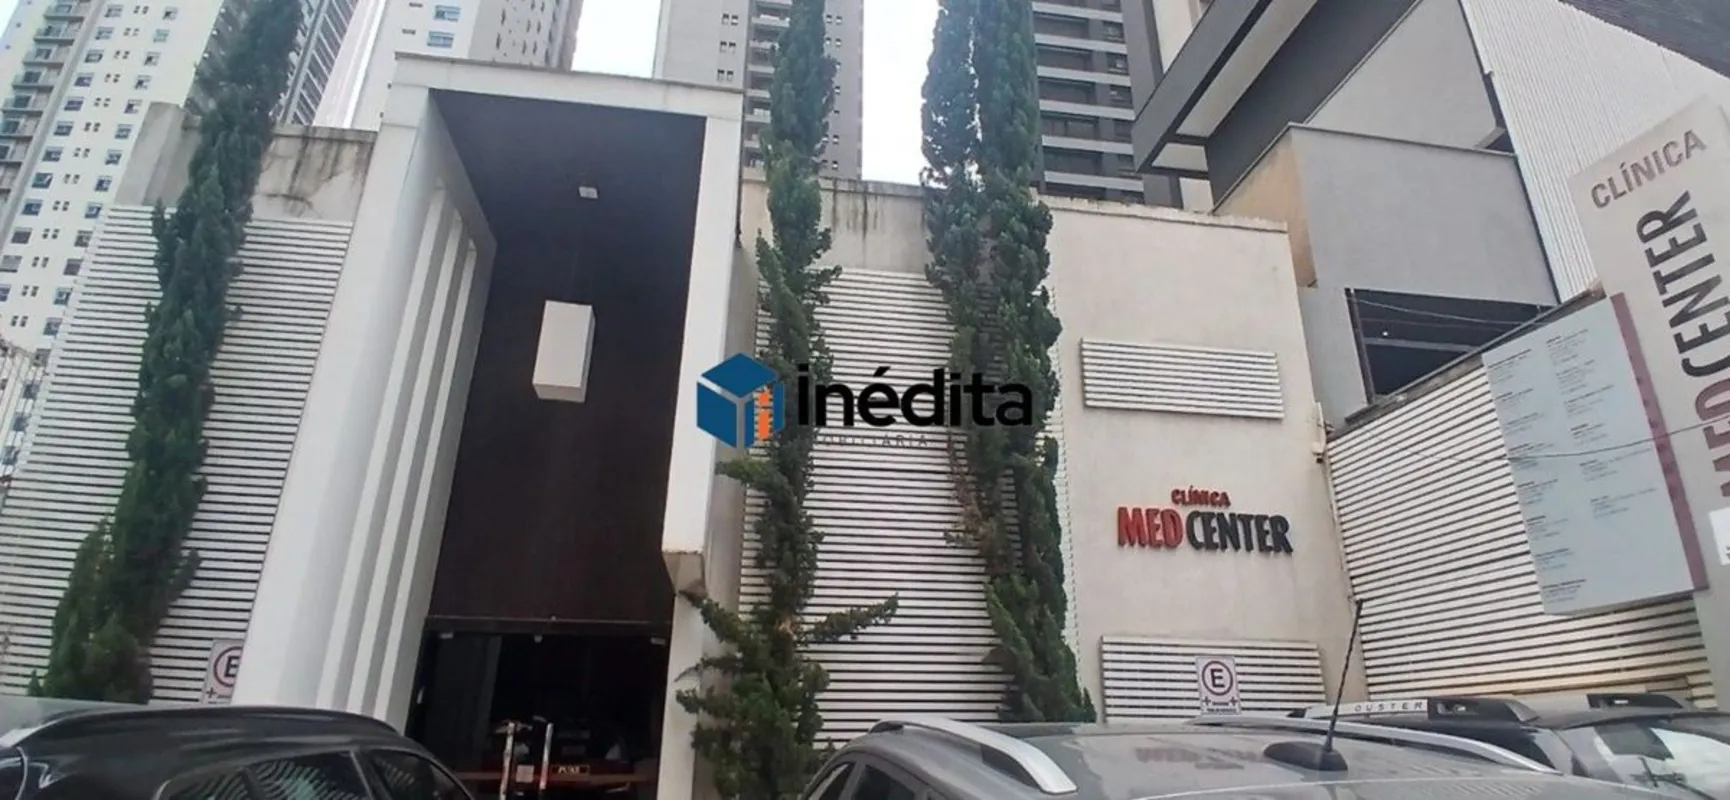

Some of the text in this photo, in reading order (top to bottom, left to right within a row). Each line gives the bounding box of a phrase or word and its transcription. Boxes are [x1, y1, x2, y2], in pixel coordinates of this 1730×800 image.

[1590, 129, 1707, 209] CLÍNICA
[1636, 190, 1730, 377] CENTER
[1171, 485, 1231, 507] CLÍNICA
[1117, 507, 1293, 556] MED CENTER
[223, 655, 241, 678] E
[1210, 668, 1225, 688] E
